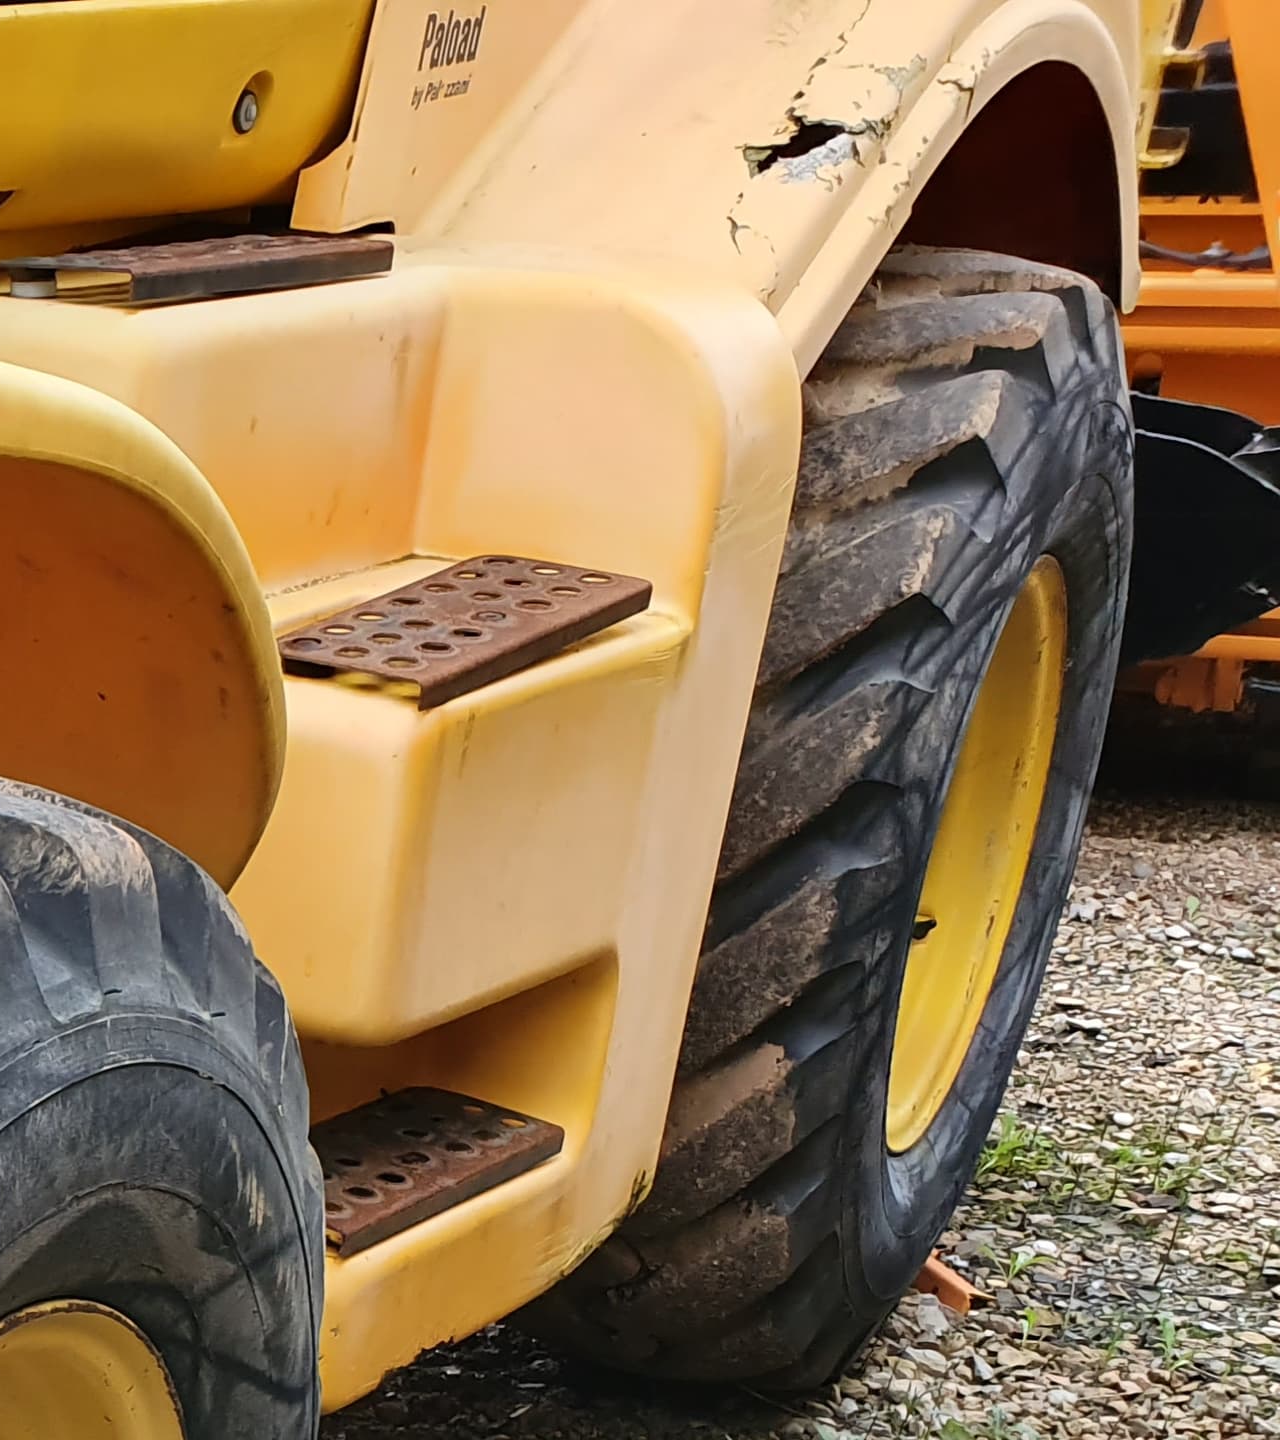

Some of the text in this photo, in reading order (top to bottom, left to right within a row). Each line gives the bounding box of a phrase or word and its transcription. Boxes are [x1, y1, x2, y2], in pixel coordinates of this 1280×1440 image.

[417, 4, 486, 72] Paload
[410, 73, 472, 111] by Palzzani
